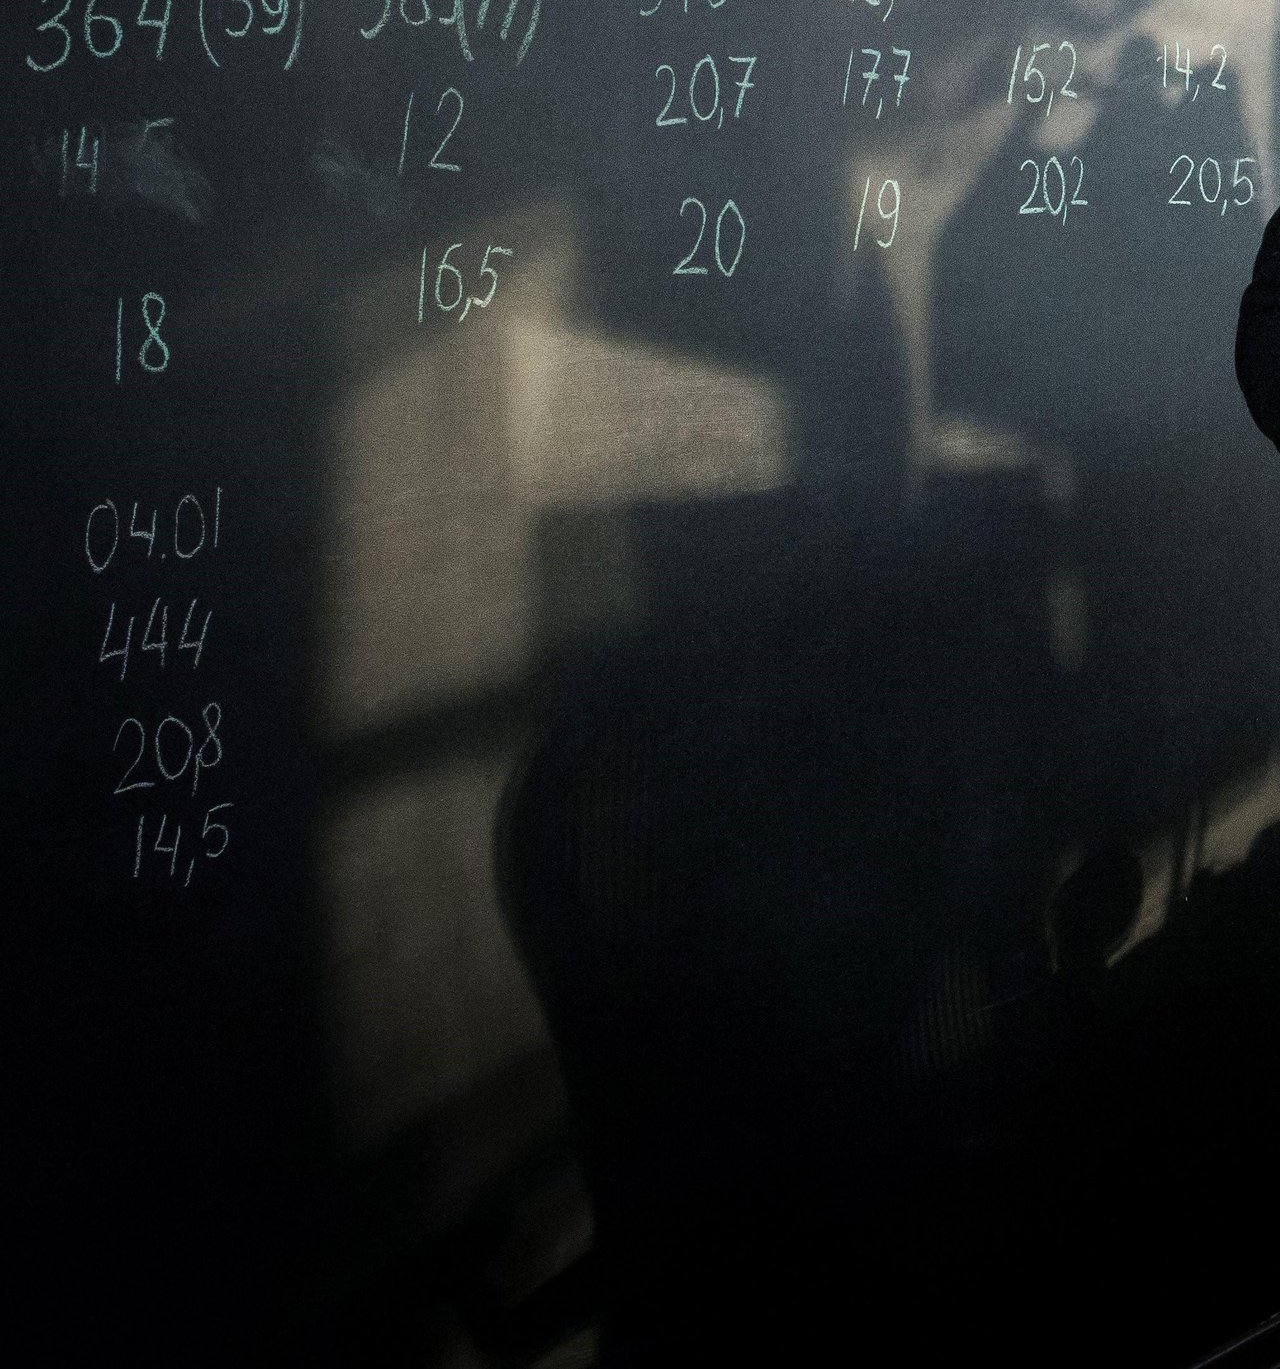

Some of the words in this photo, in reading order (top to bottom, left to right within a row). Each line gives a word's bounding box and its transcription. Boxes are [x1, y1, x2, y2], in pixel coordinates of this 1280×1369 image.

[655, 54, 757, 129] 20,7
[842, 47, 911, 119] 17,7
[1007, 41, 1078, 116] 15,2
[1156, 43, 1227, 102] 14,2
[400, 88, 464, 175] 12
[853, 177, 901, 251] 19
[1018, 156, 1088, 226] 20,2
[1168, 155, 1255, 216] 20,5
[672, 197, 746, 277] 20
[418, 243, 513, 322] 16,5
[115, 291, 169, 384] 18
[85, 487, 222, 572] 04.01
[100, 597, 212, 681] 444
[112, 702, 223, 796] 20,8
[133, 802, 234, 887] 14,5
